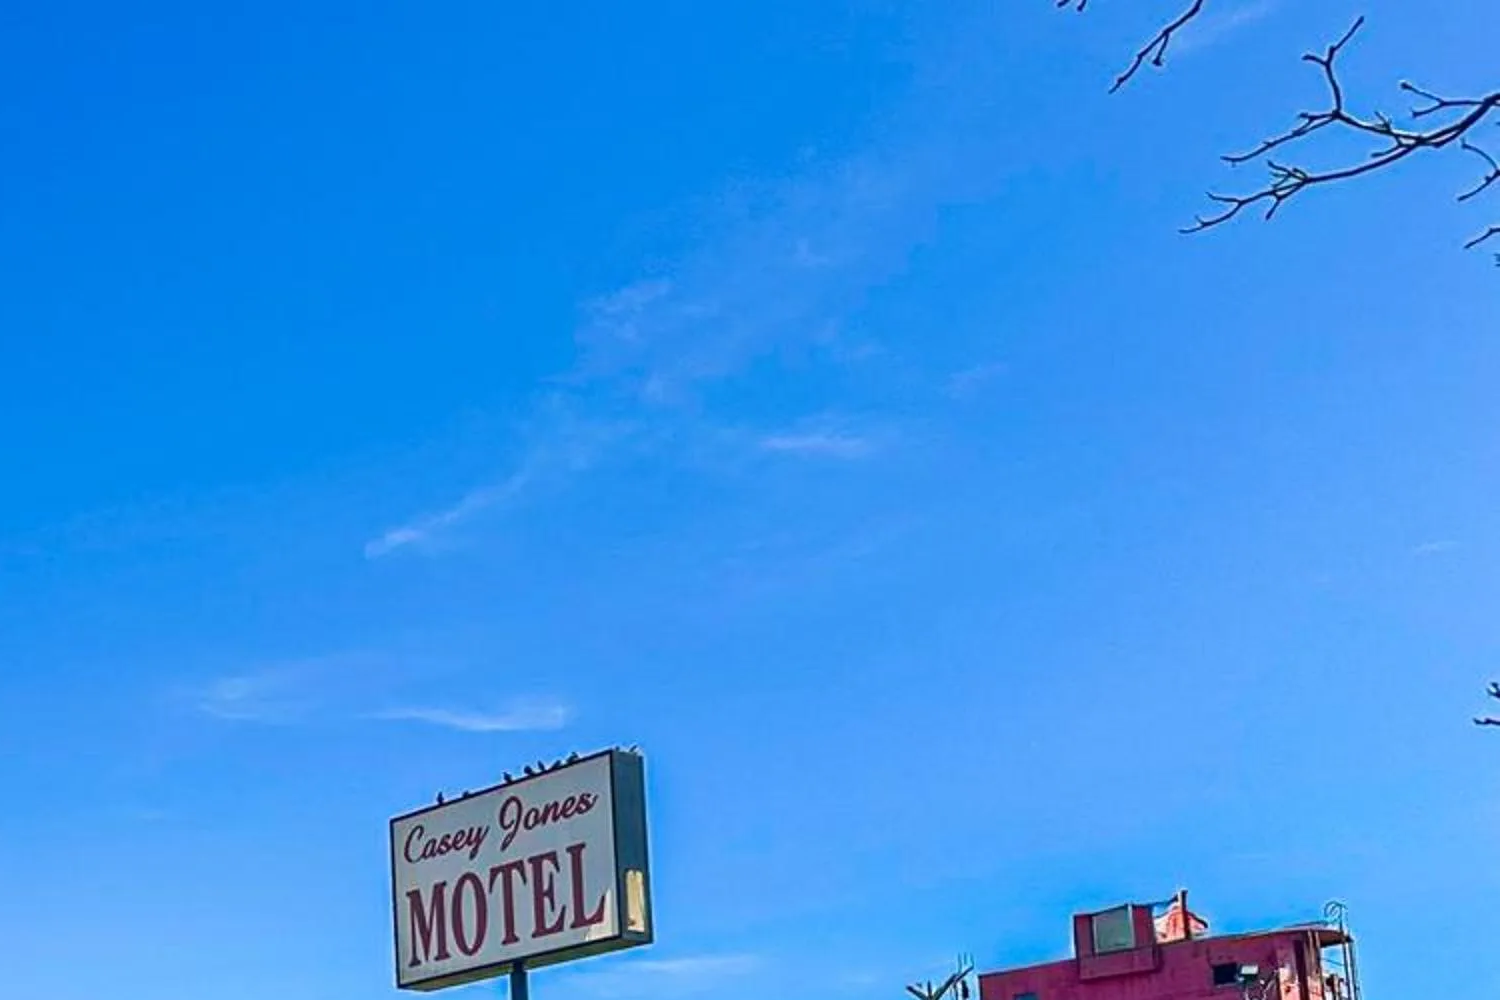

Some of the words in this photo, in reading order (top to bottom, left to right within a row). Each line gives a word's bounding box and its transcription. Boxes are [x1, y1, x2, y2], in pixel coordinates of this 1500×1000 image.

[403, 824, 490, 864] Casey
[499, 794, 598, 851] Jones
[405, 842, 606, 968] MOTEL
